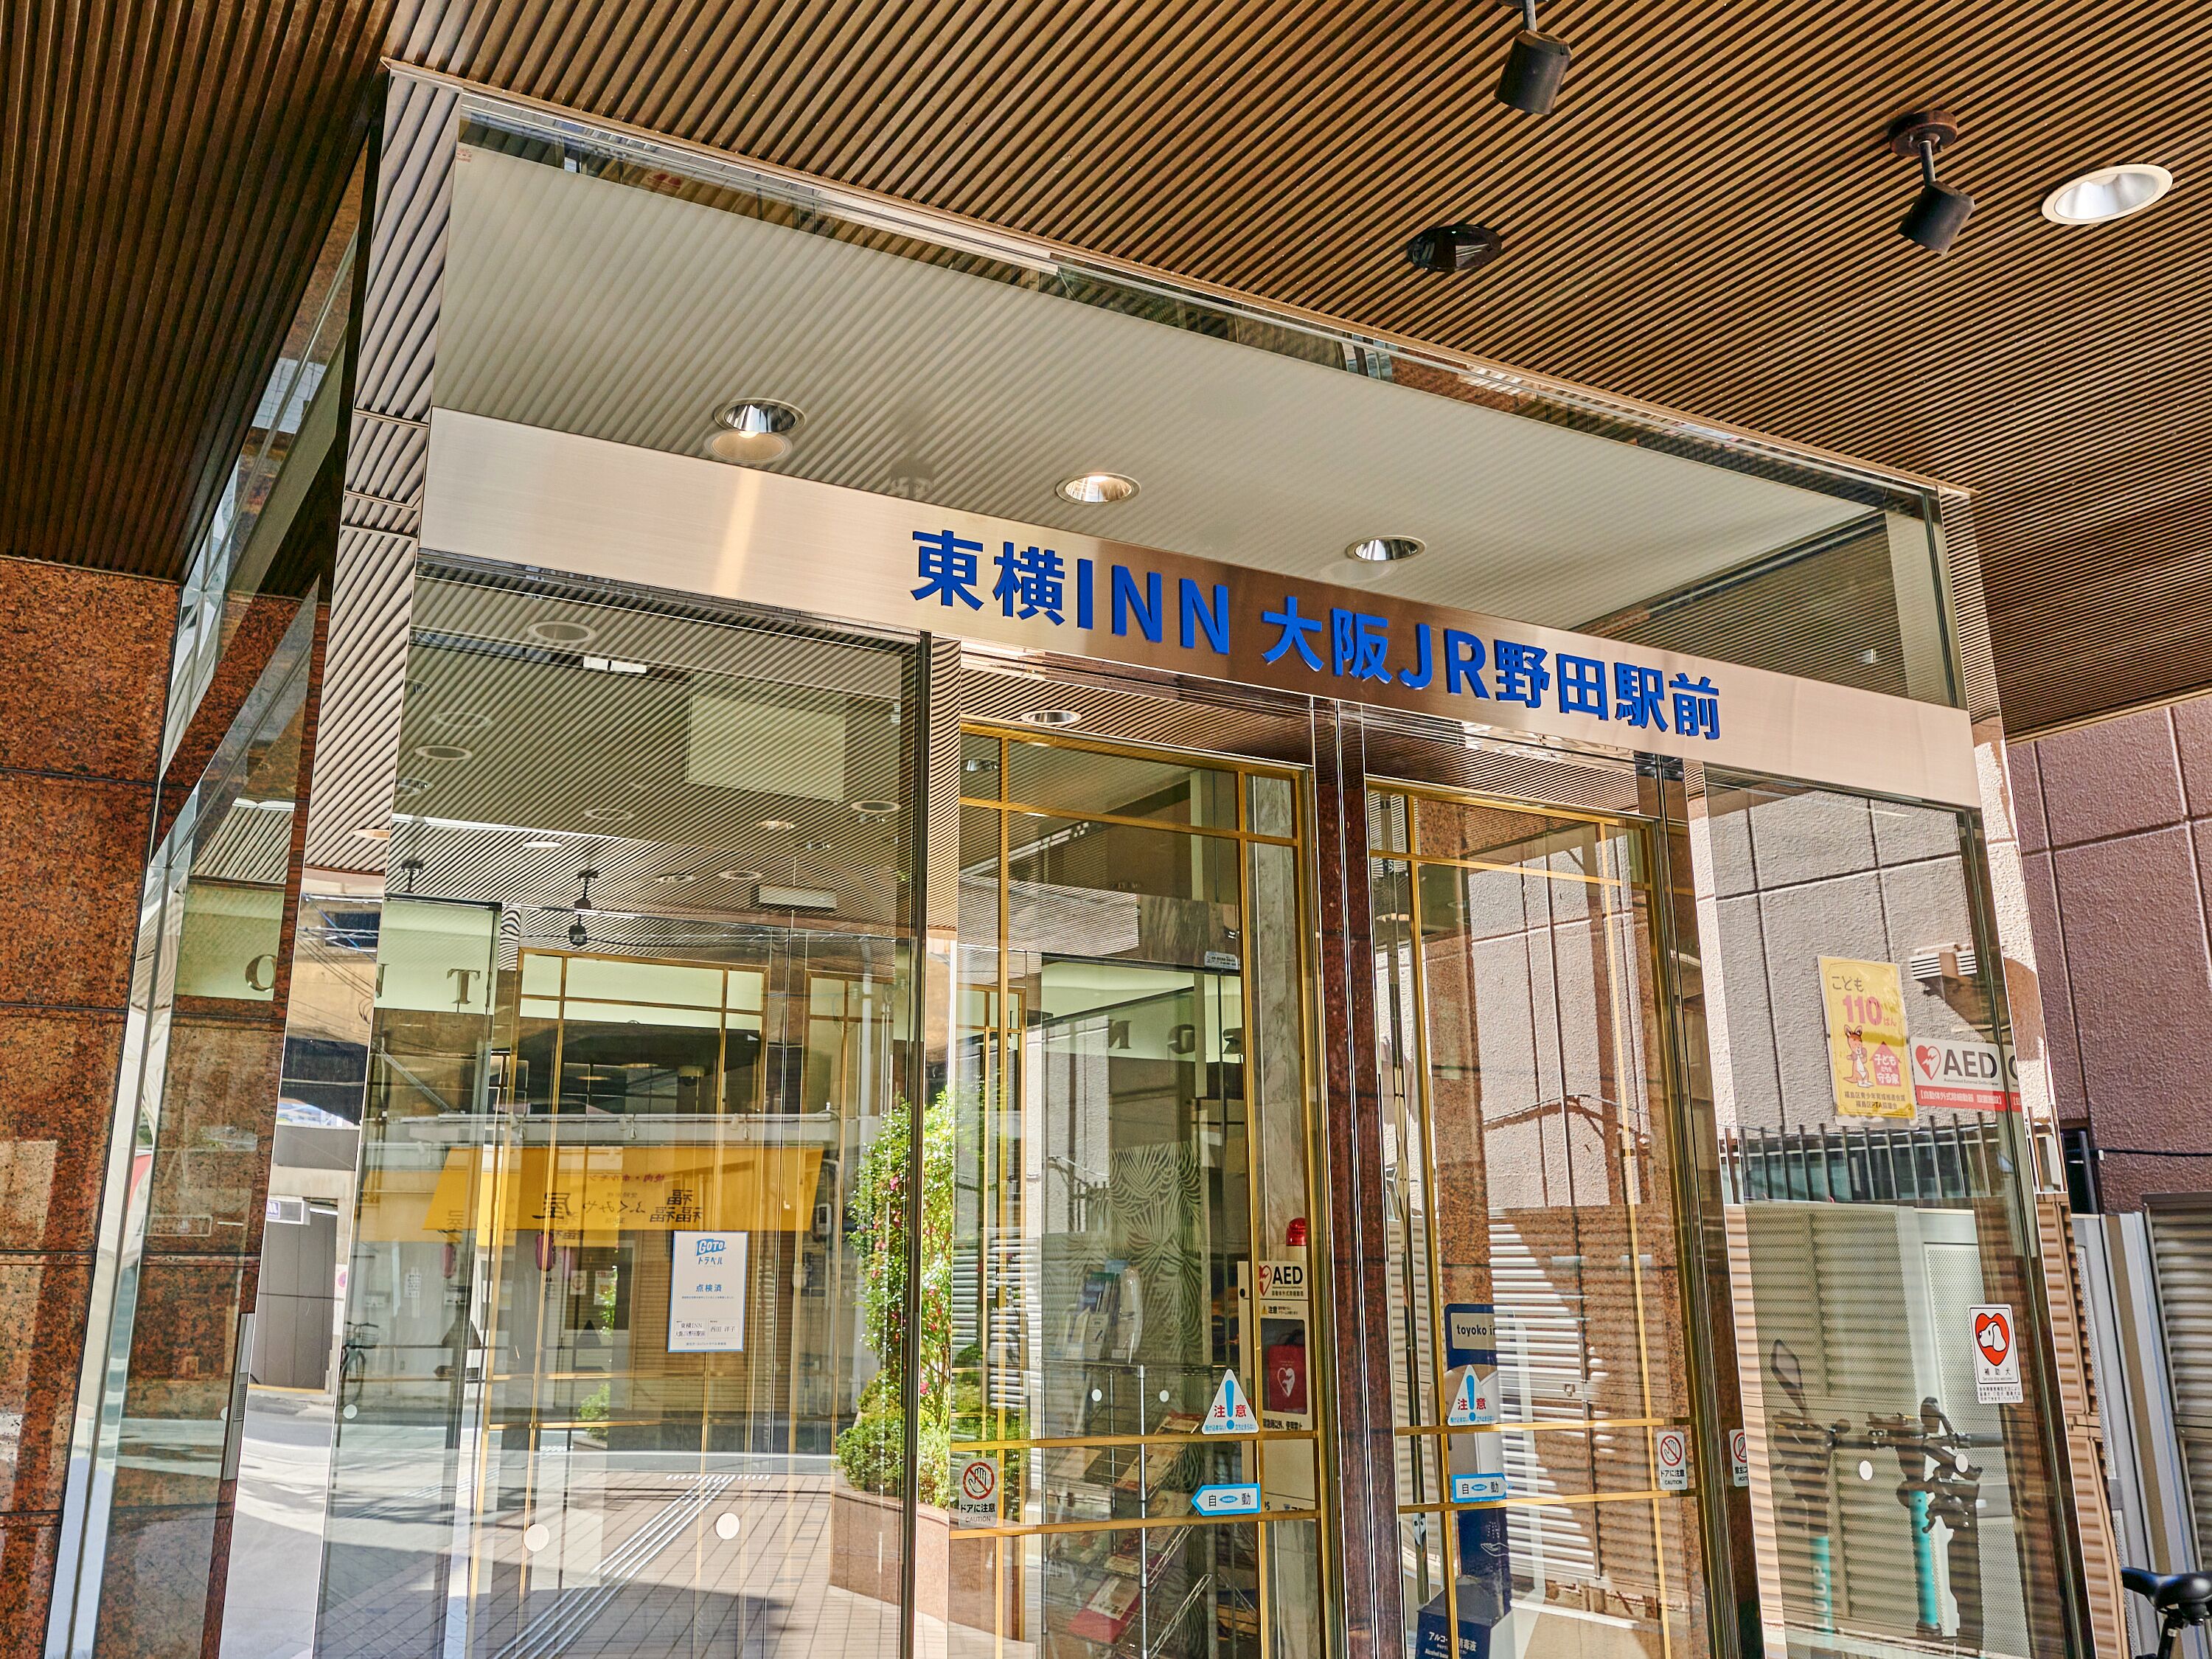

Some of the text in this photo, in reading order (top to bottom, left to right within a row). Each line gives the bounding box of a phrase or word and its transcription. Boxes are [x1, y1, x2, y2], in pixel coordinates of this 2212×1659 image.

[911, 529, 1722, 740] 東横INN 大阪JR野田駅前
[1832, 975, 1864, 992] こども
[1944, 1049, 1997, 1079] AED
[698, 1256, 723, 1265] トラベル
[1273, 1266, 1304, 1284] AED
[696, 1284, 722, 1293] 点検済
[1457, 1324, 1487, 1338] toyoko
[1660, 1469, 1685, 1478] ドアに注意
[961, 1503, 995, 1513] ドアに注意
